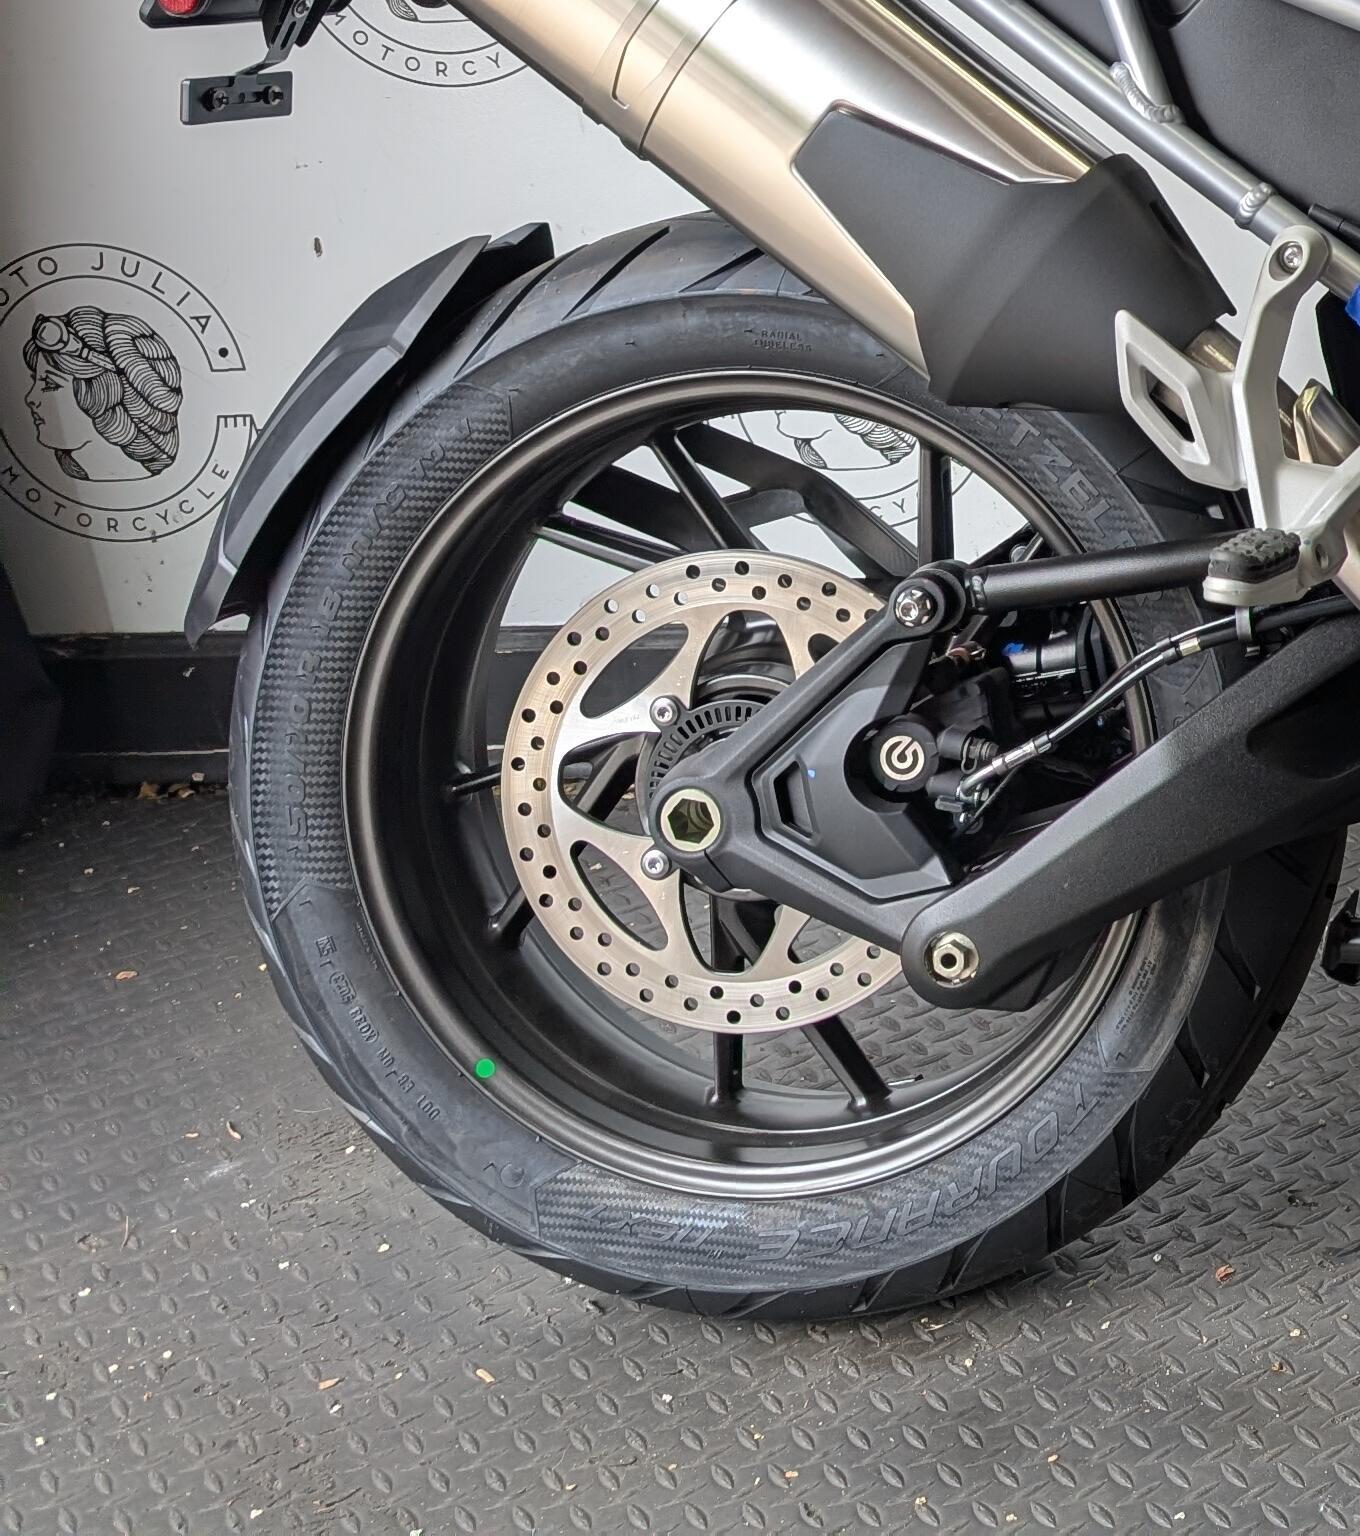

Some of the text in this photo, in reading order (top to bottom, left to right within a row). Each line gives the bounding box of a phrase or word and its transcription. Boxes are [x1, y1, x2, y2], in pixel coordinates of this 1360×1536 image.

[334, 12, 505, 77] MOTORCY
[0, 252, 212, 334] OTO JULIA
[2, 464, 231, 533] MOTORCYCLE
